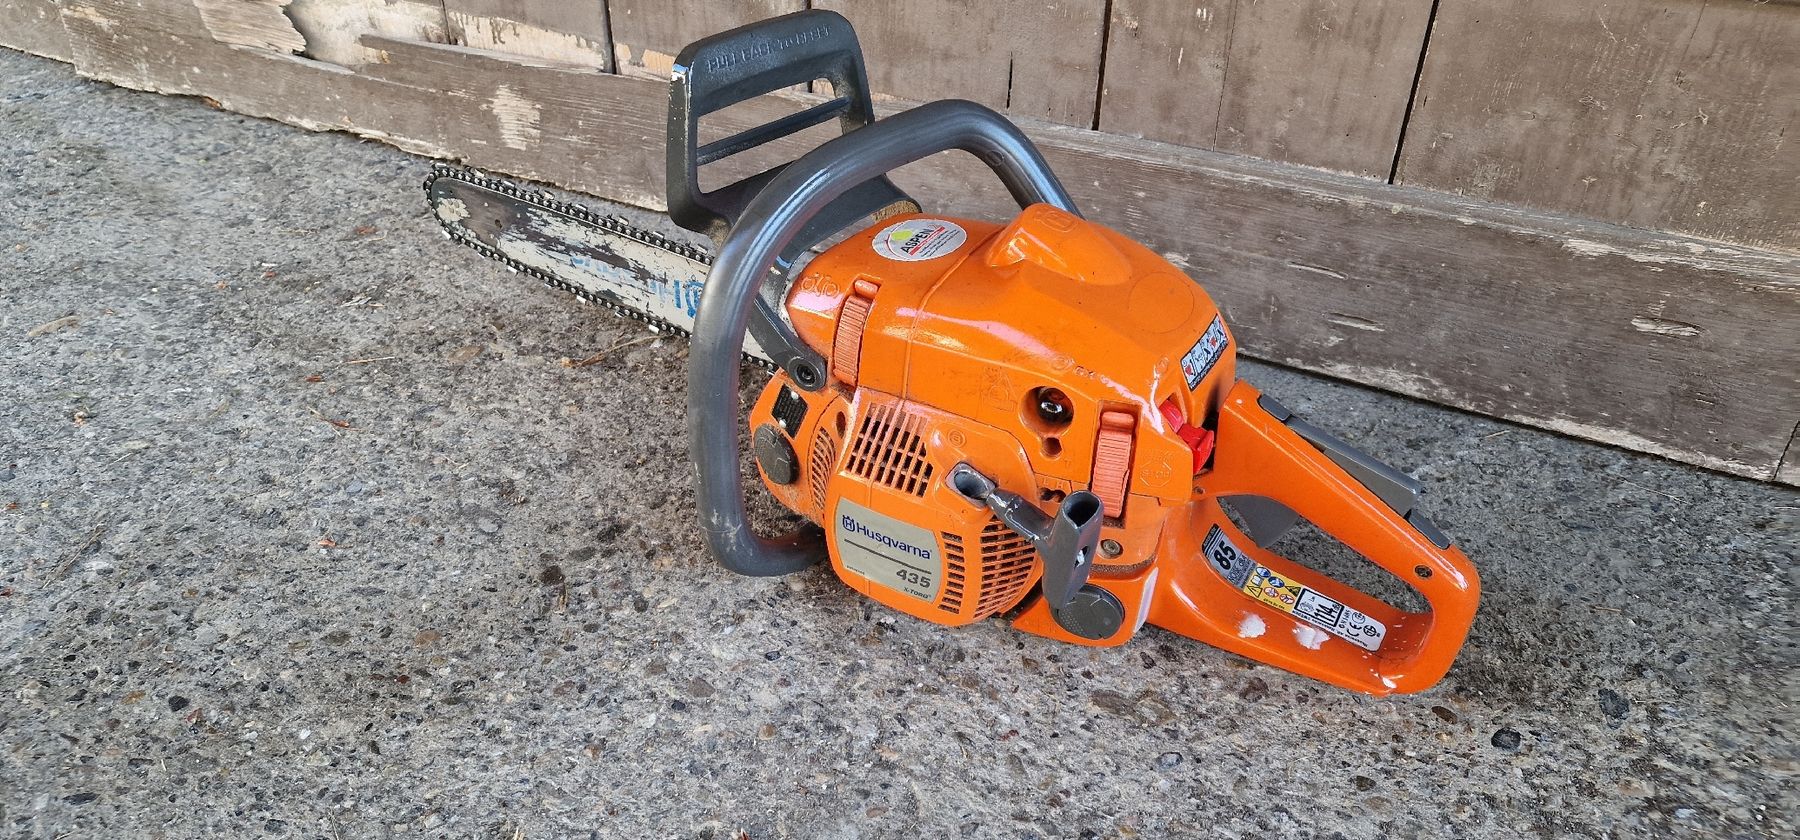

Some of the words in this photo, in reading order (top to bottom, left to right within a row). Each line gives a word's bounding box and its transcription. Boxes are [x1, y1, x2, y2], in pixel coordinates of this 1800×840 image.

[900, 228, 935, 254] ASPEN
[856, 521, 931, 560] Husqvarna
[1214, 540, 1237, 570] 85
[896, 569, 931, 589] 435
[1314, 604, 1338, 622] 114
